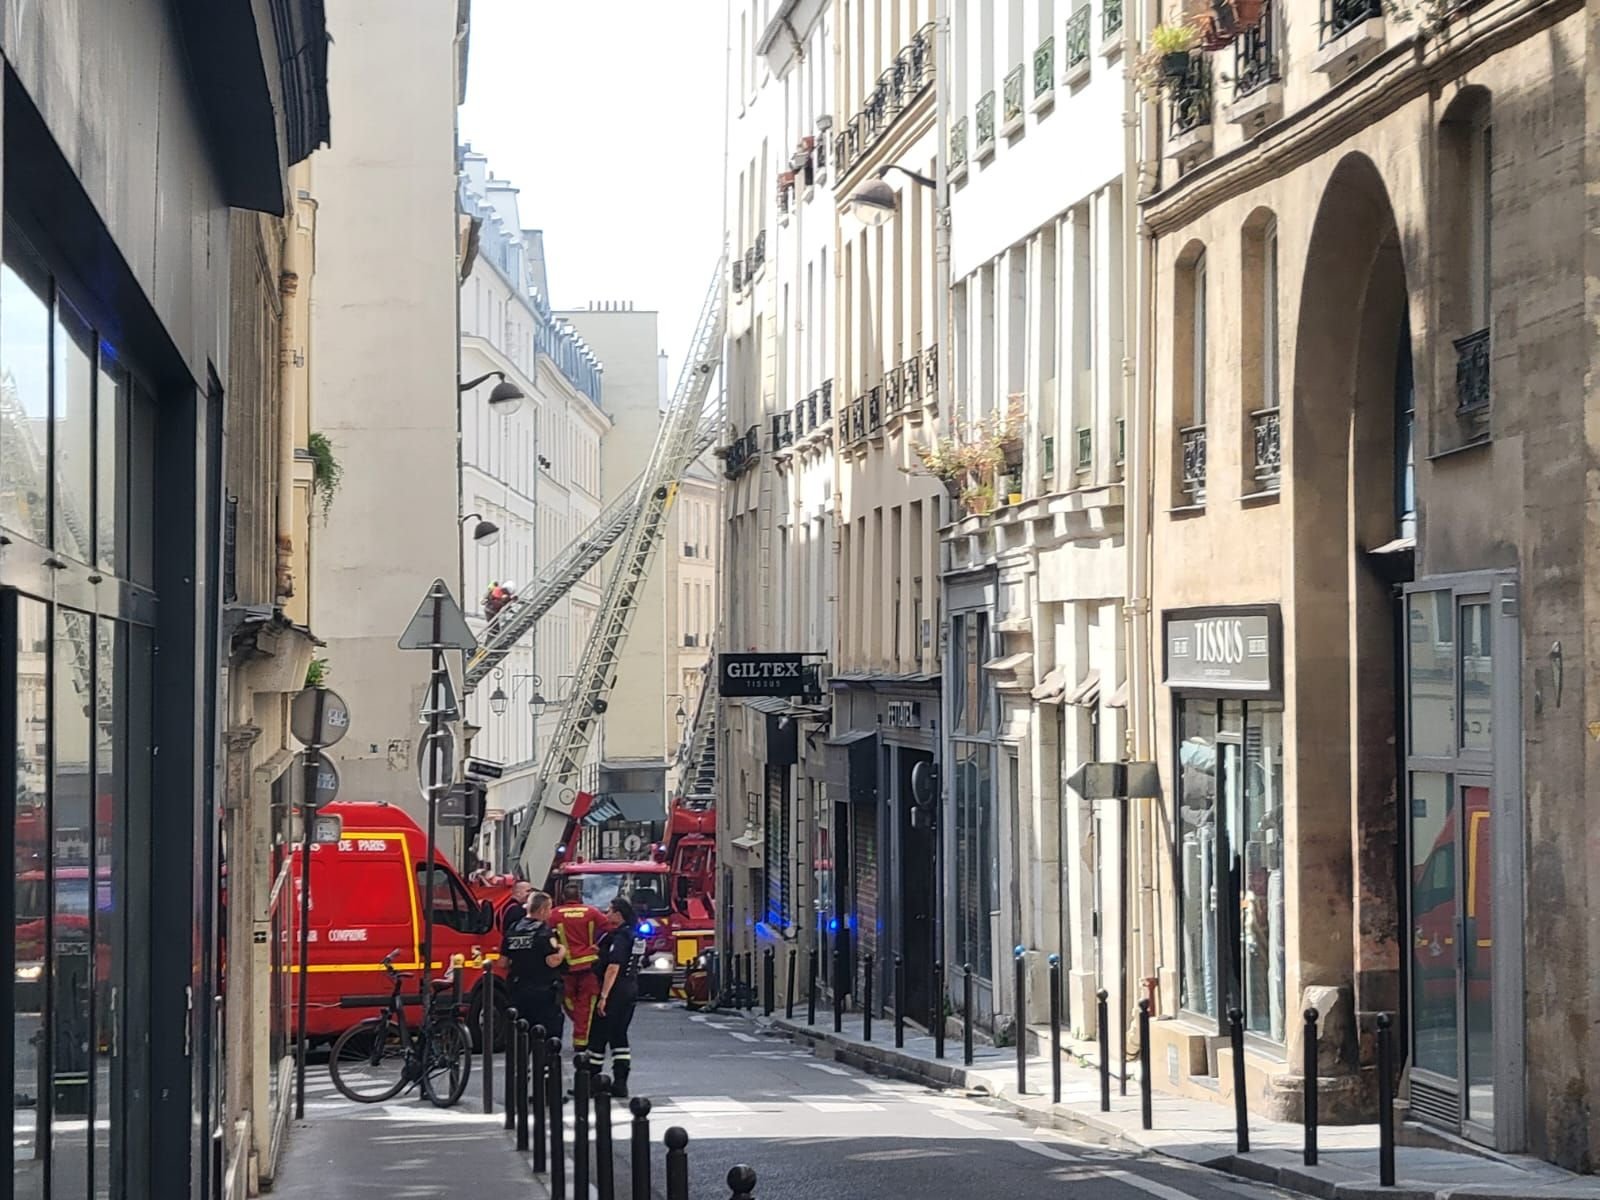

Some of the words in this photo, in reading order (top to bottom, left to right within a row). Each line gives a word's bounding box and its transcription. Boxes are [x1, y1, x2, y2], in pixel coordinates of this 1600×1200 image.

[1194, 620, 1243, 663] TISSUS
[727, 662, 800, 678] GILTEX
[746, 680, 781, 688] TISSUS
[337, 840, 353, 851] DE
[358, 839, 387, 851] PARIS
